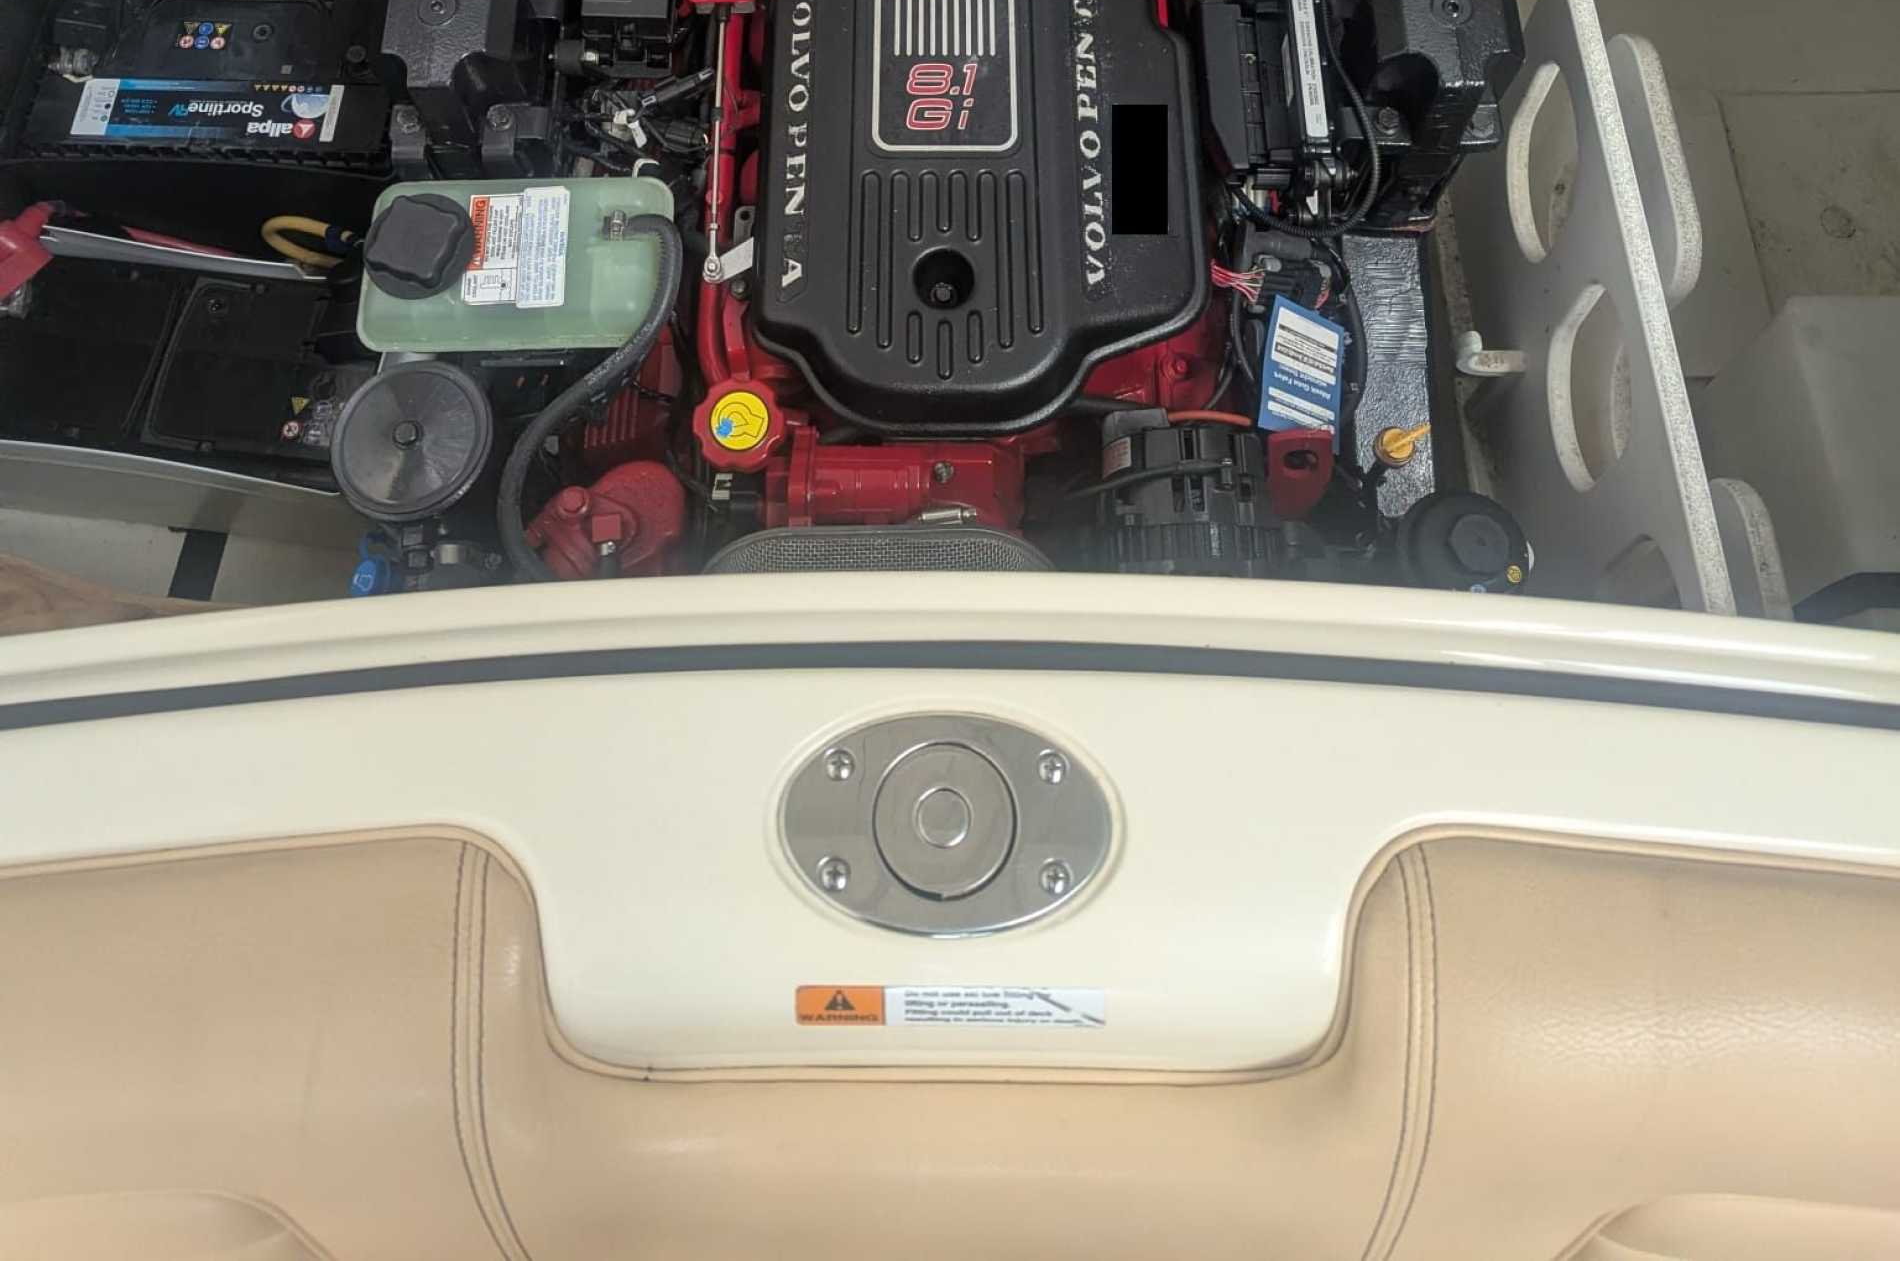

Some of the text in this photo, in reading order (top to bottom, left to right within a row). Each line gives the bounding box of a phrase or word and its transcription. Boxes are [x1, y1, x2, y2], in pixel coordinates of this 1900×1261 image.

[905, 62, 978, 96] 8.1
[188, 100, 264, 117] Sportline
[905, 97, 975, 130] Gi
[247, 119, 294, 137] allpa
[781, 121, 808, 287] PENA
[1079, 129, 1106, 285] VOLVO
[474, 200, 486, 255] WARNING
[800, 1013, 879, 1022] WARNING
